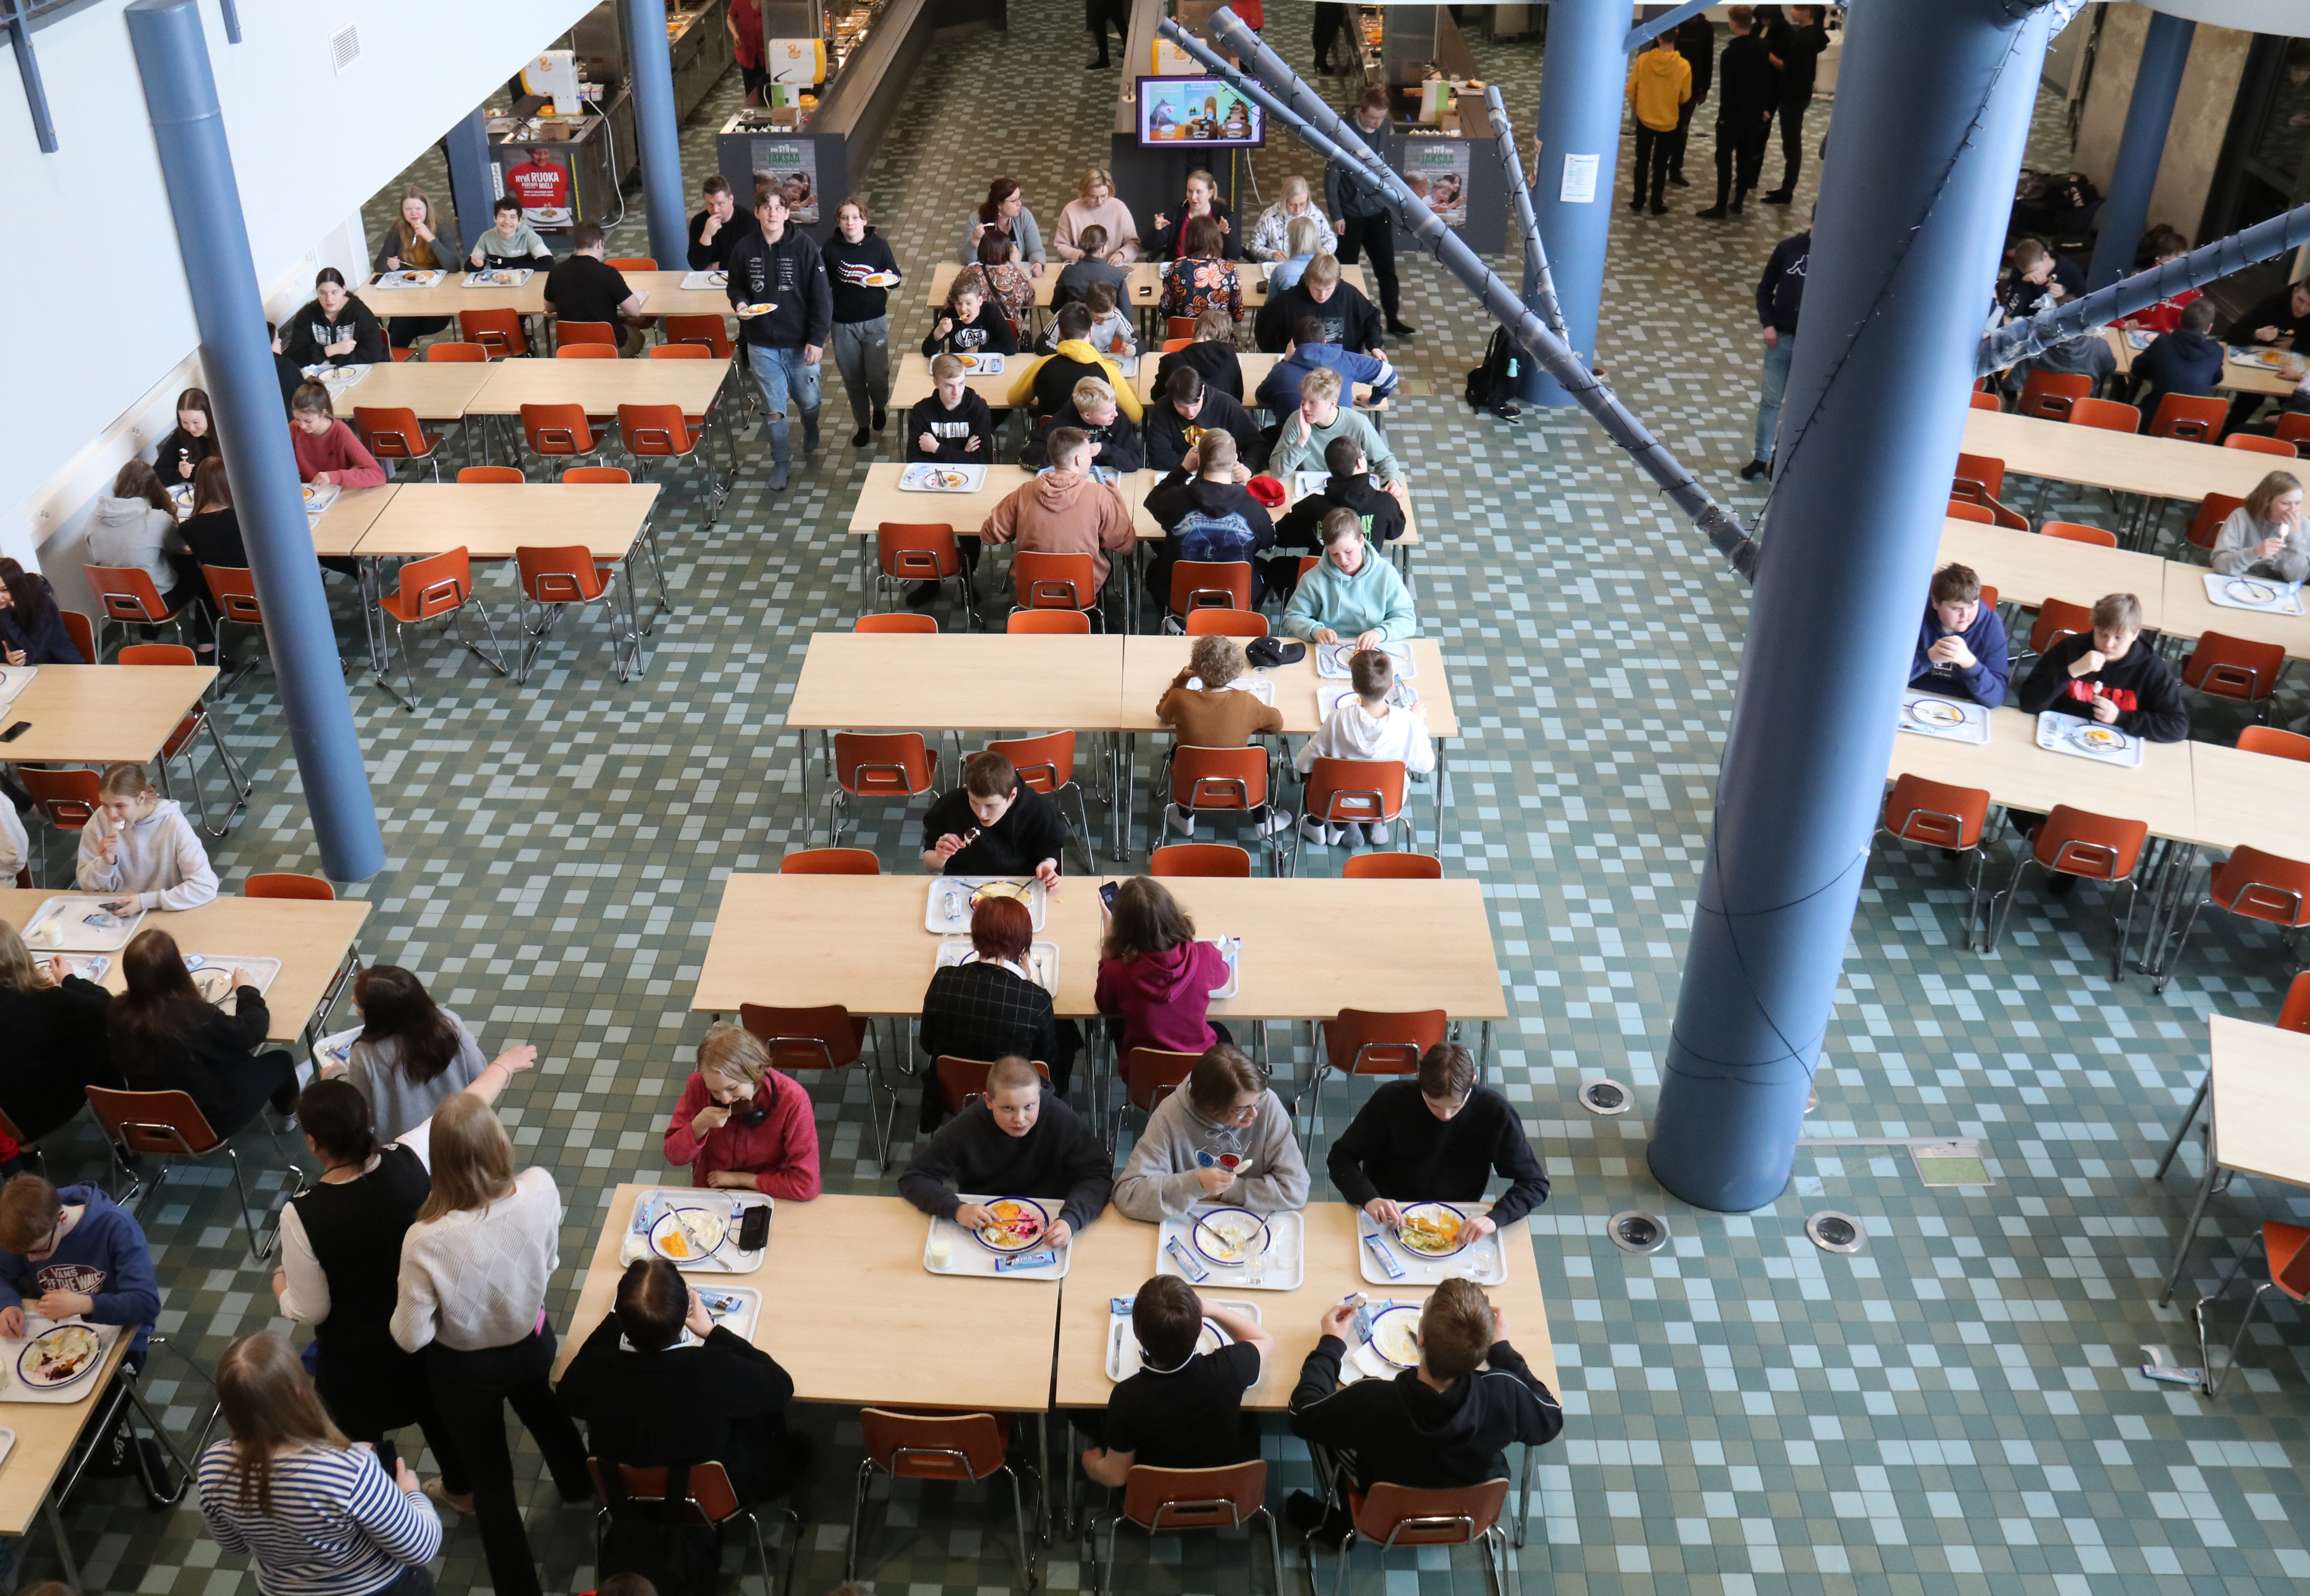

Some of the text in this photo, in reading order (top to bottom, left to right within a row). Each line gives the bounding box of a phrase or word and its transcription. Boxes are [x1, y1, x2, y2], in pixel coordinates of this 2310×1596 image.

[768, 153, 800, 164] JAKSAA
[1420, 154, 1454, 165] JAKSAA
[515, 172, 559, 182] HYVÄ RUOKA
[49, 1266, 78, 1278] VANS
